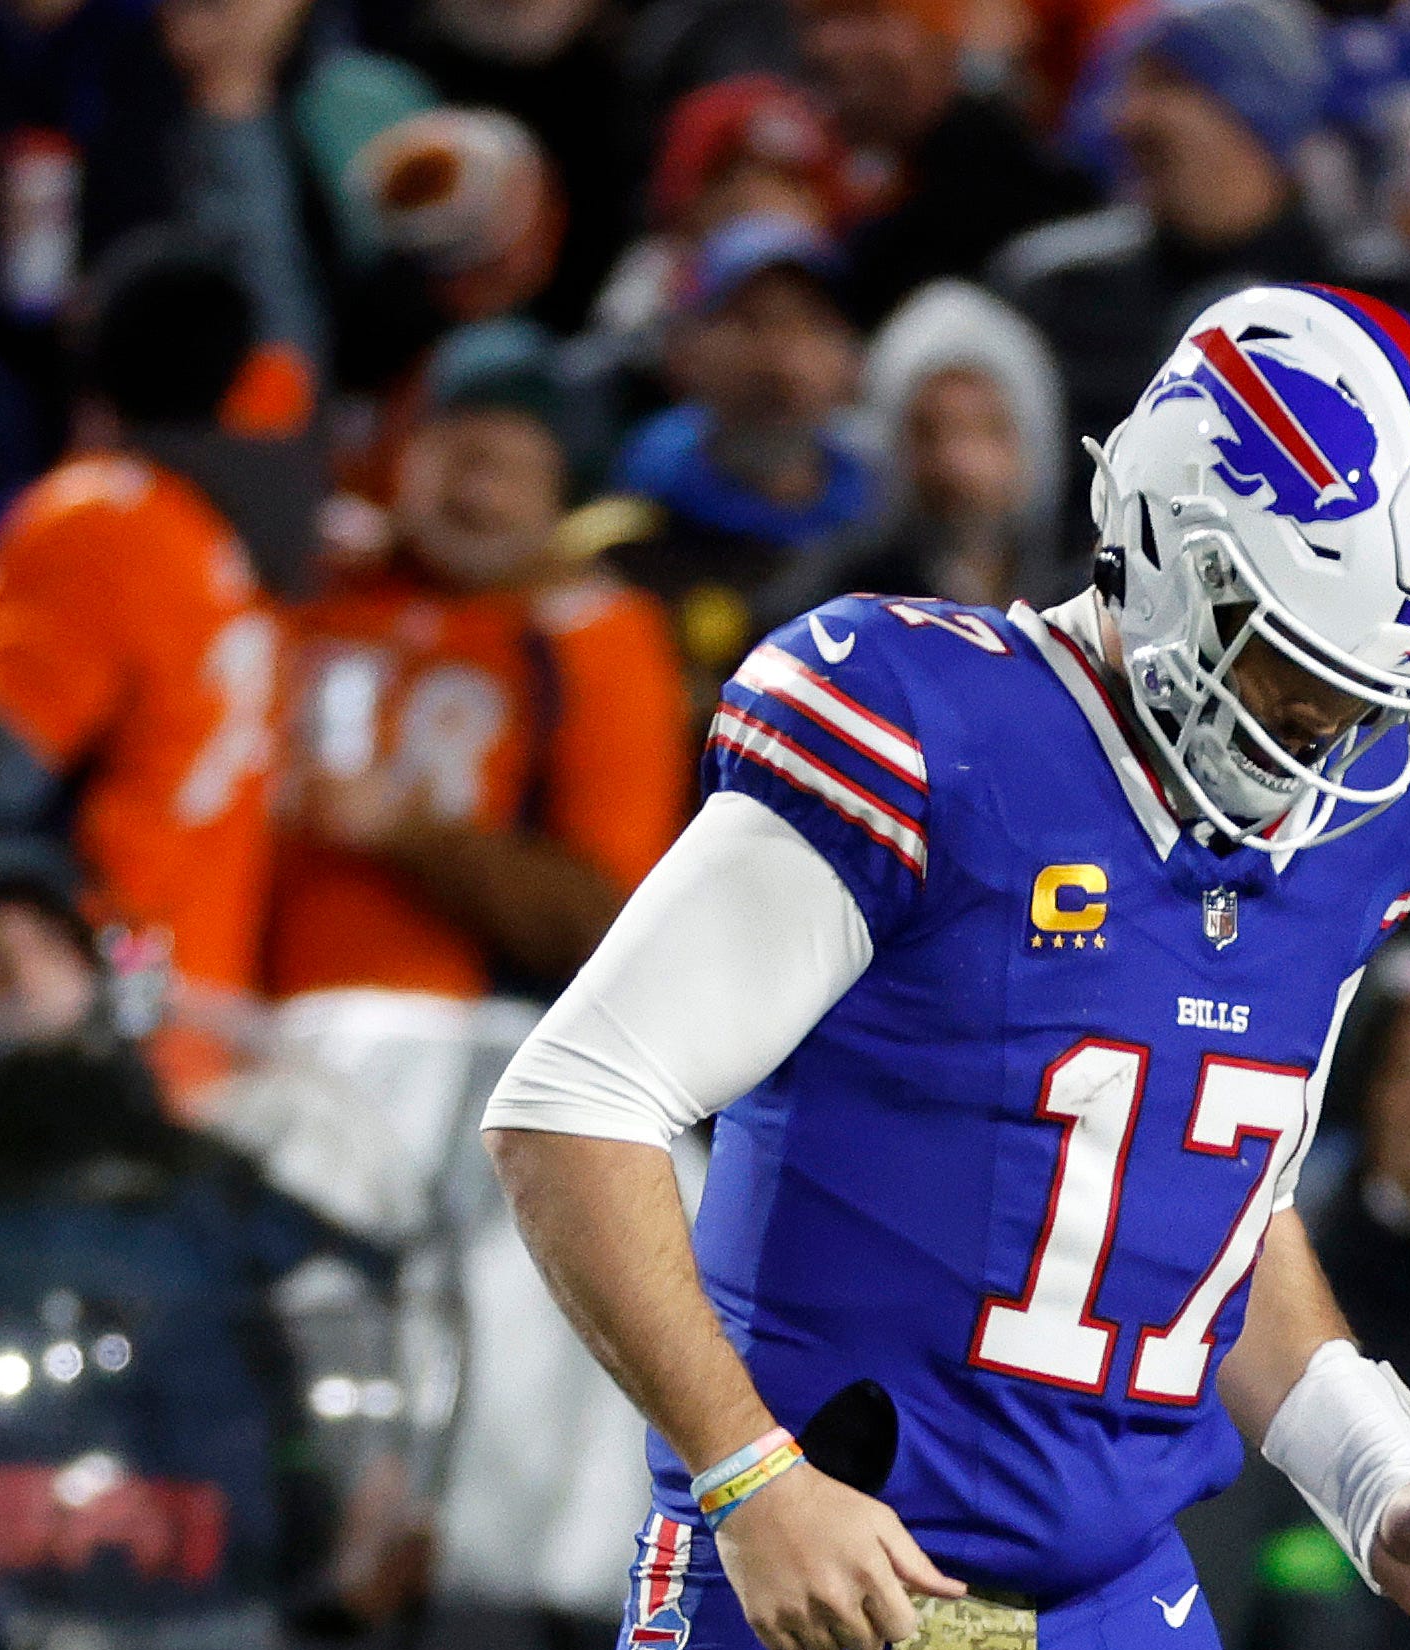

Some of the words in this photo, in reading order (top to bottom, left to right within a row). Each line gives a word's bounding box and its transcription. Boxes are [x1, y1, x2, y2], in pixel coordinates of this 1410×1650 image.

[1031, 863, 1108, 932] C
[1177, 997, 1250, 1032] BILLS
[968, 1037, 1309, 1406] 17
